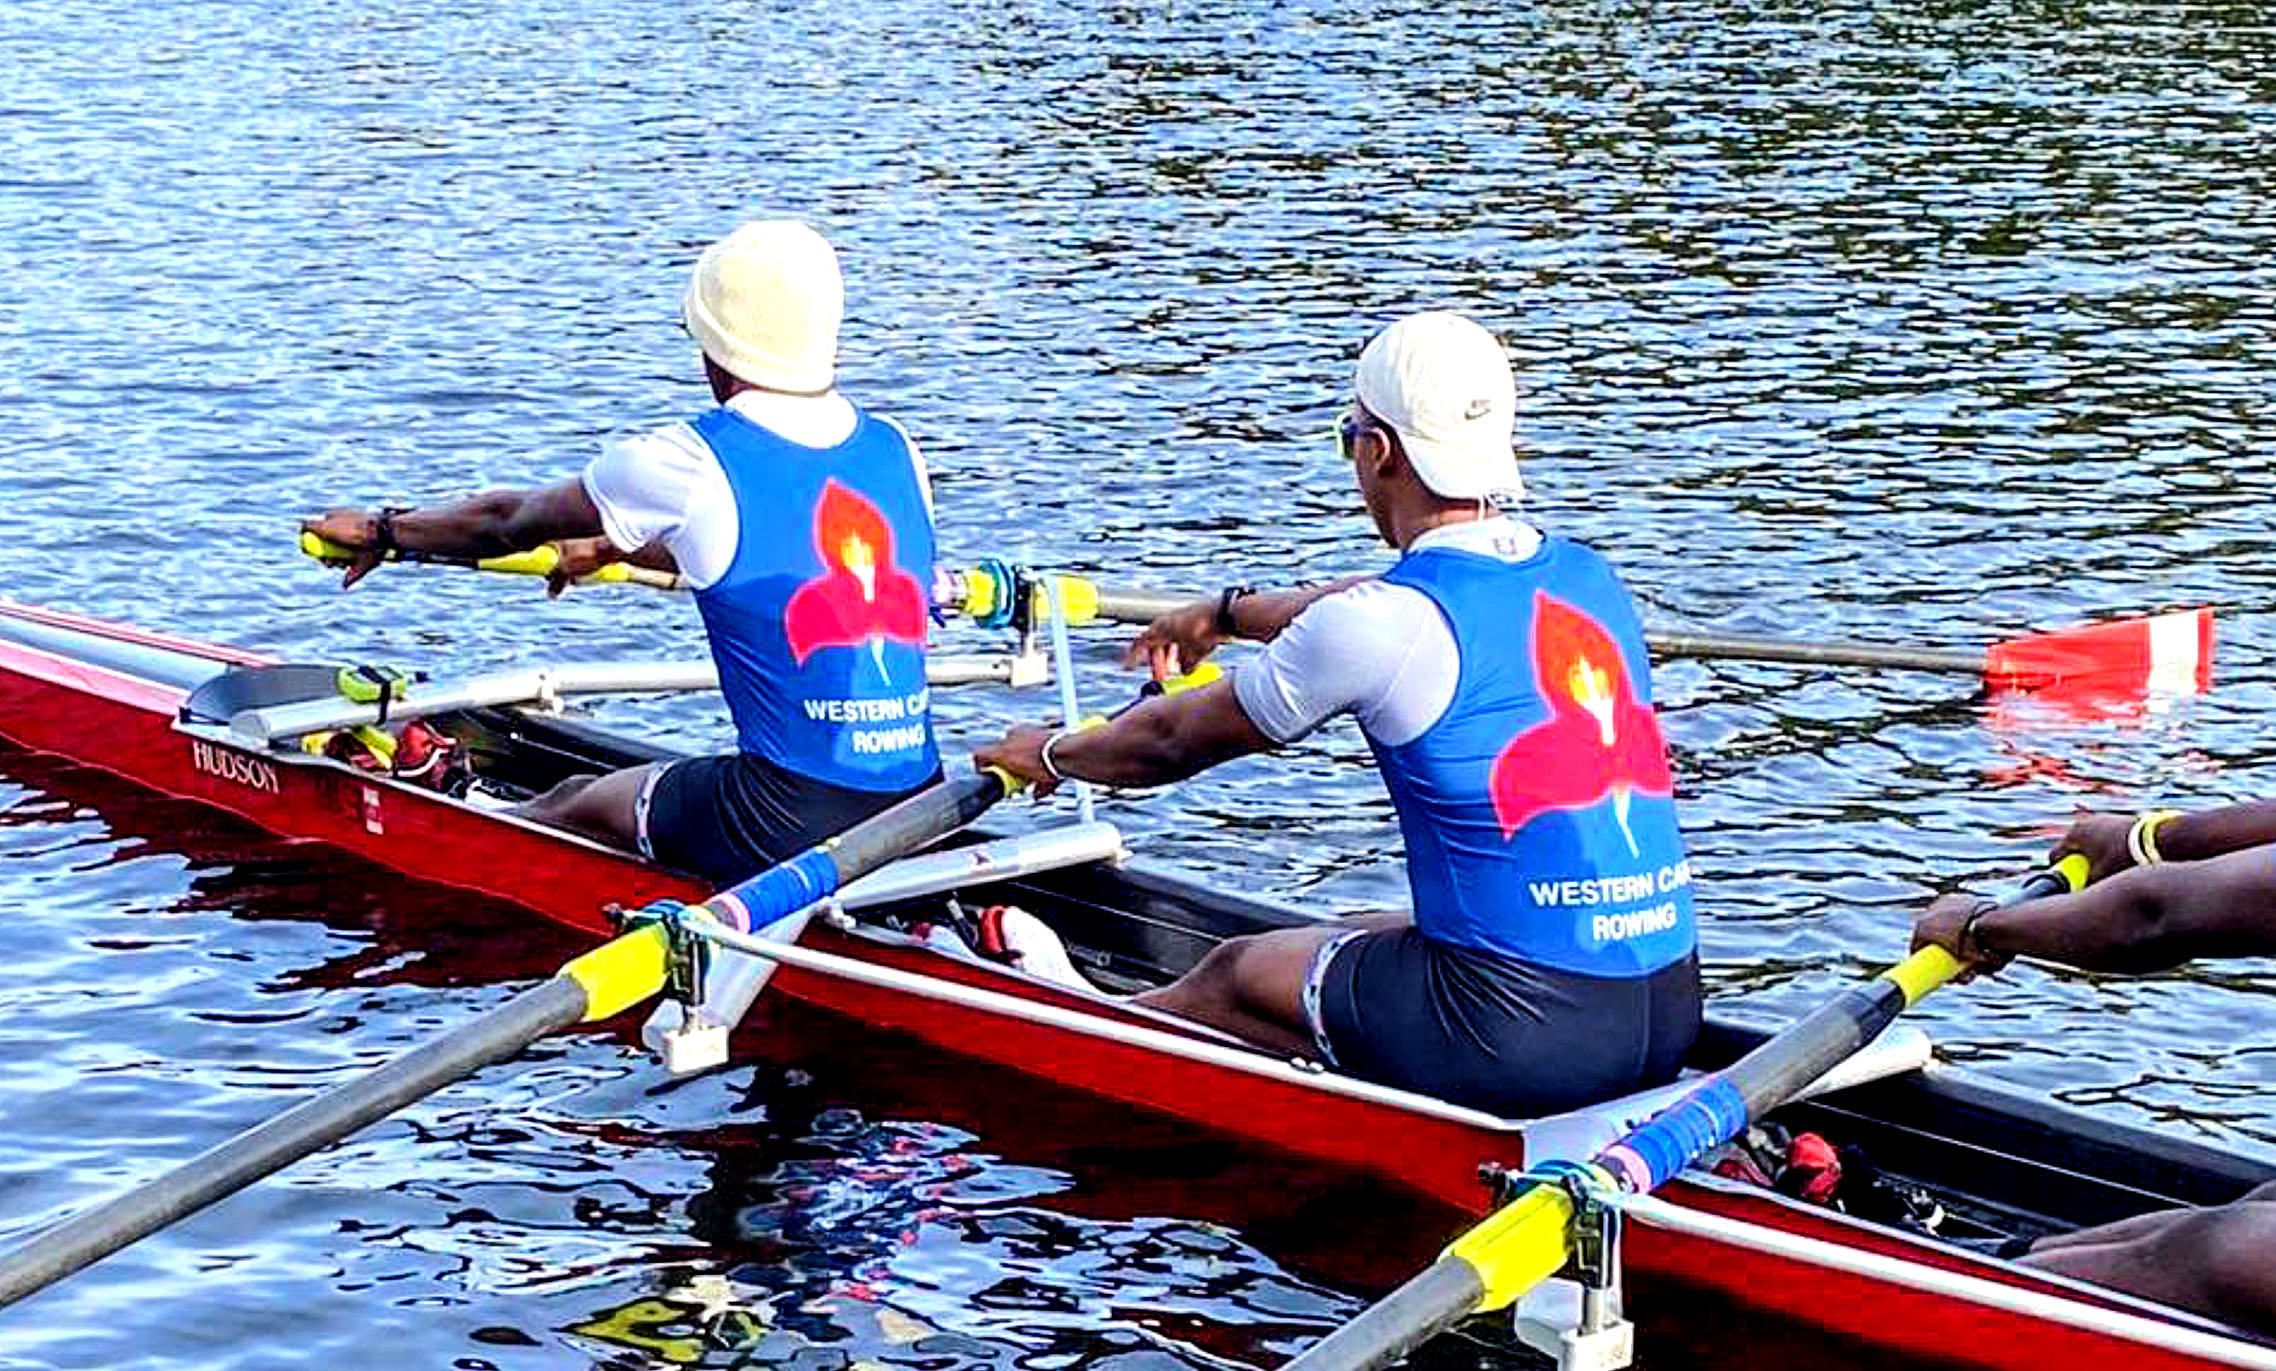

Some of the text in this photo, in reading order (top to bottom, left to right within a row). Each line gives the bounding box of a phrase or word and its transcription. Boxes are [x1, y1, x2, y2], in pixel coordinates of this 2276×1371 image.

[804, 697, 904, 722] WESTERN
[852, 725, 925, 753] ROWING
[193, 742, 279, 793] HUDSON
[1529, 872, 1654, 906] WESTERN
[1593, 903, 1676, 940] ROWING
